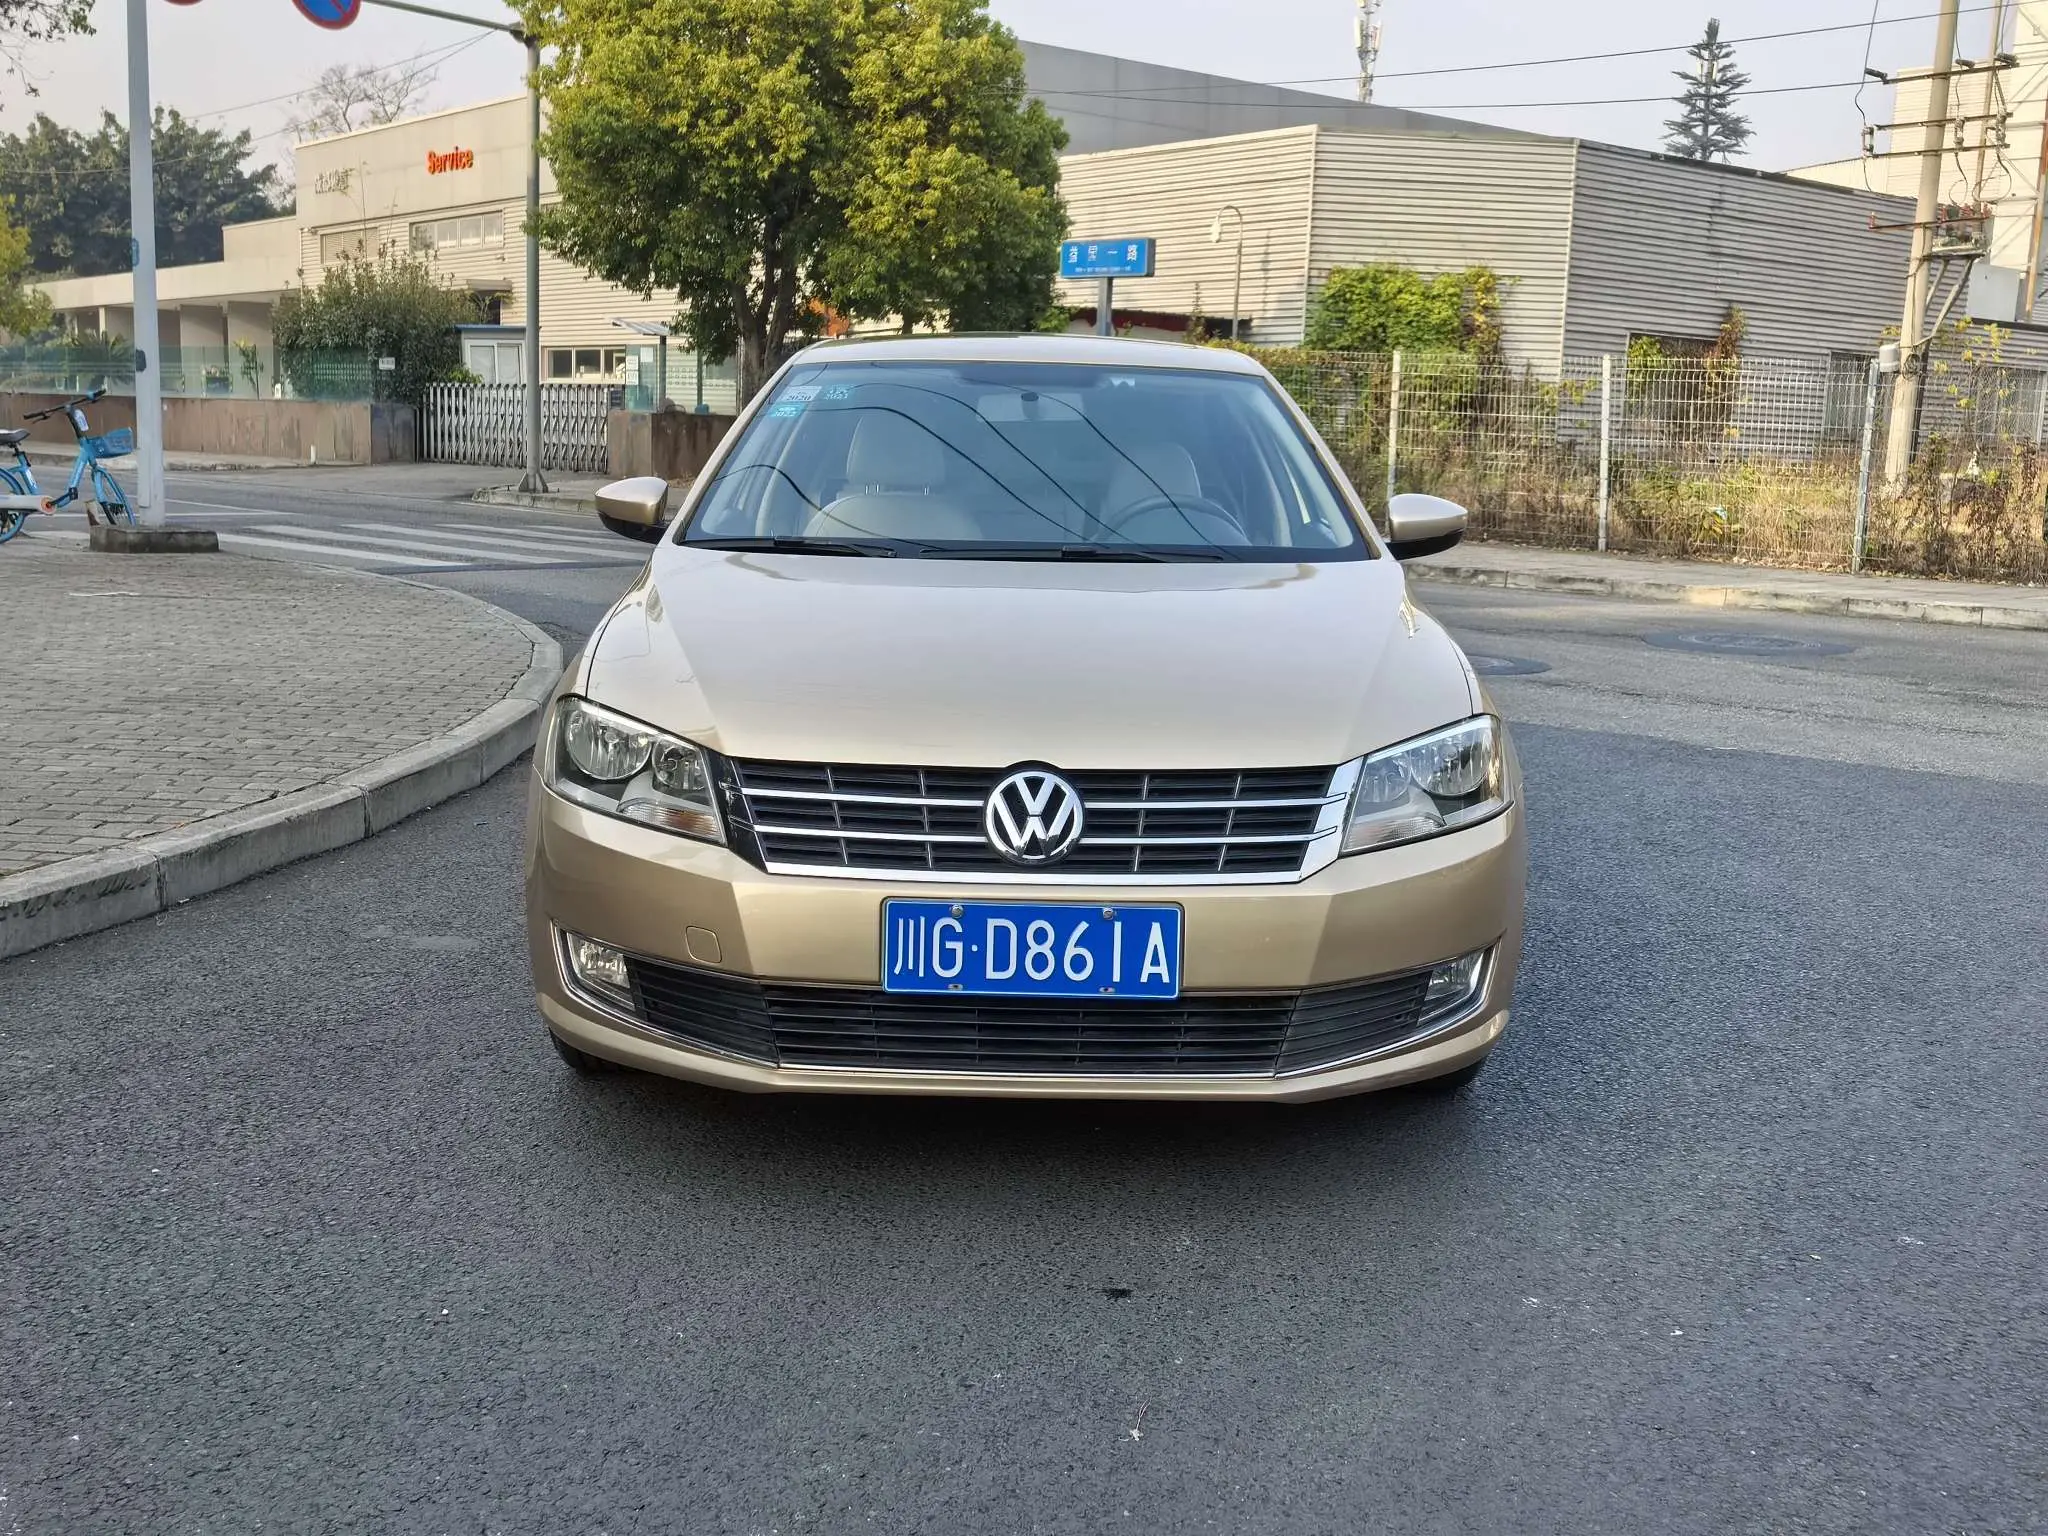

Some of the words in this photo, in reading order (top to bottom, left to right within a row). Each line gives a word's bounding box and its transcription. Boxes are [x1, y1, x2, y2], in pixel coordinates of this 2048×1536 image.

[428, 146, 474, 175] Service
[987, 772, 1082, 861] VW
[893, 915, 1171, 984] 川G·D861A
